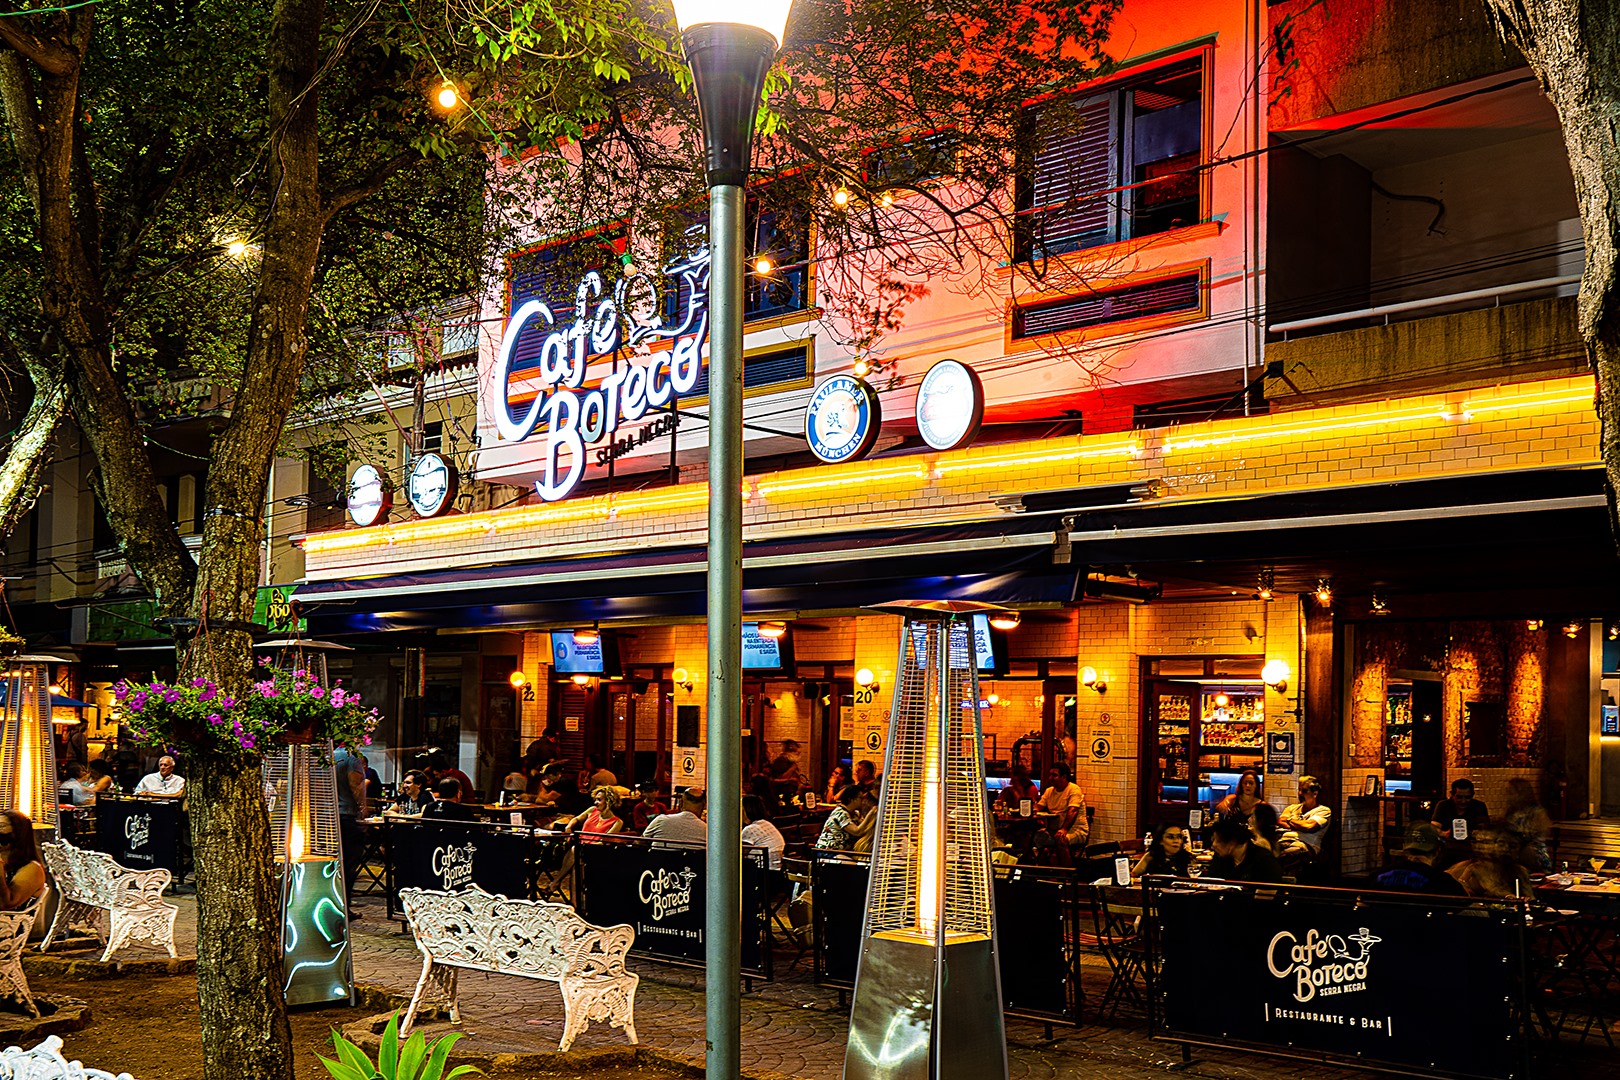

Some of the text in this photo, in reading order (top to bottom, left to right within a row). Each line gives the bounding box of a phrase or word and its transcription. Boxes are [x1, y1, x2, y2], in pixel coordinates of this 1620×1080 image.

[810, 379, 865, 417] PAULANER
[523, 689, 535, 702] 22
[855, 690, 872, 704] 20
[652, 888, 691, 921] Boteco
[1293, 957, 1370, 1003] Boteco
[1319, 982, 1367, 997] SERRA NEGRA
[1349, 1017, 1356, 1026] &
